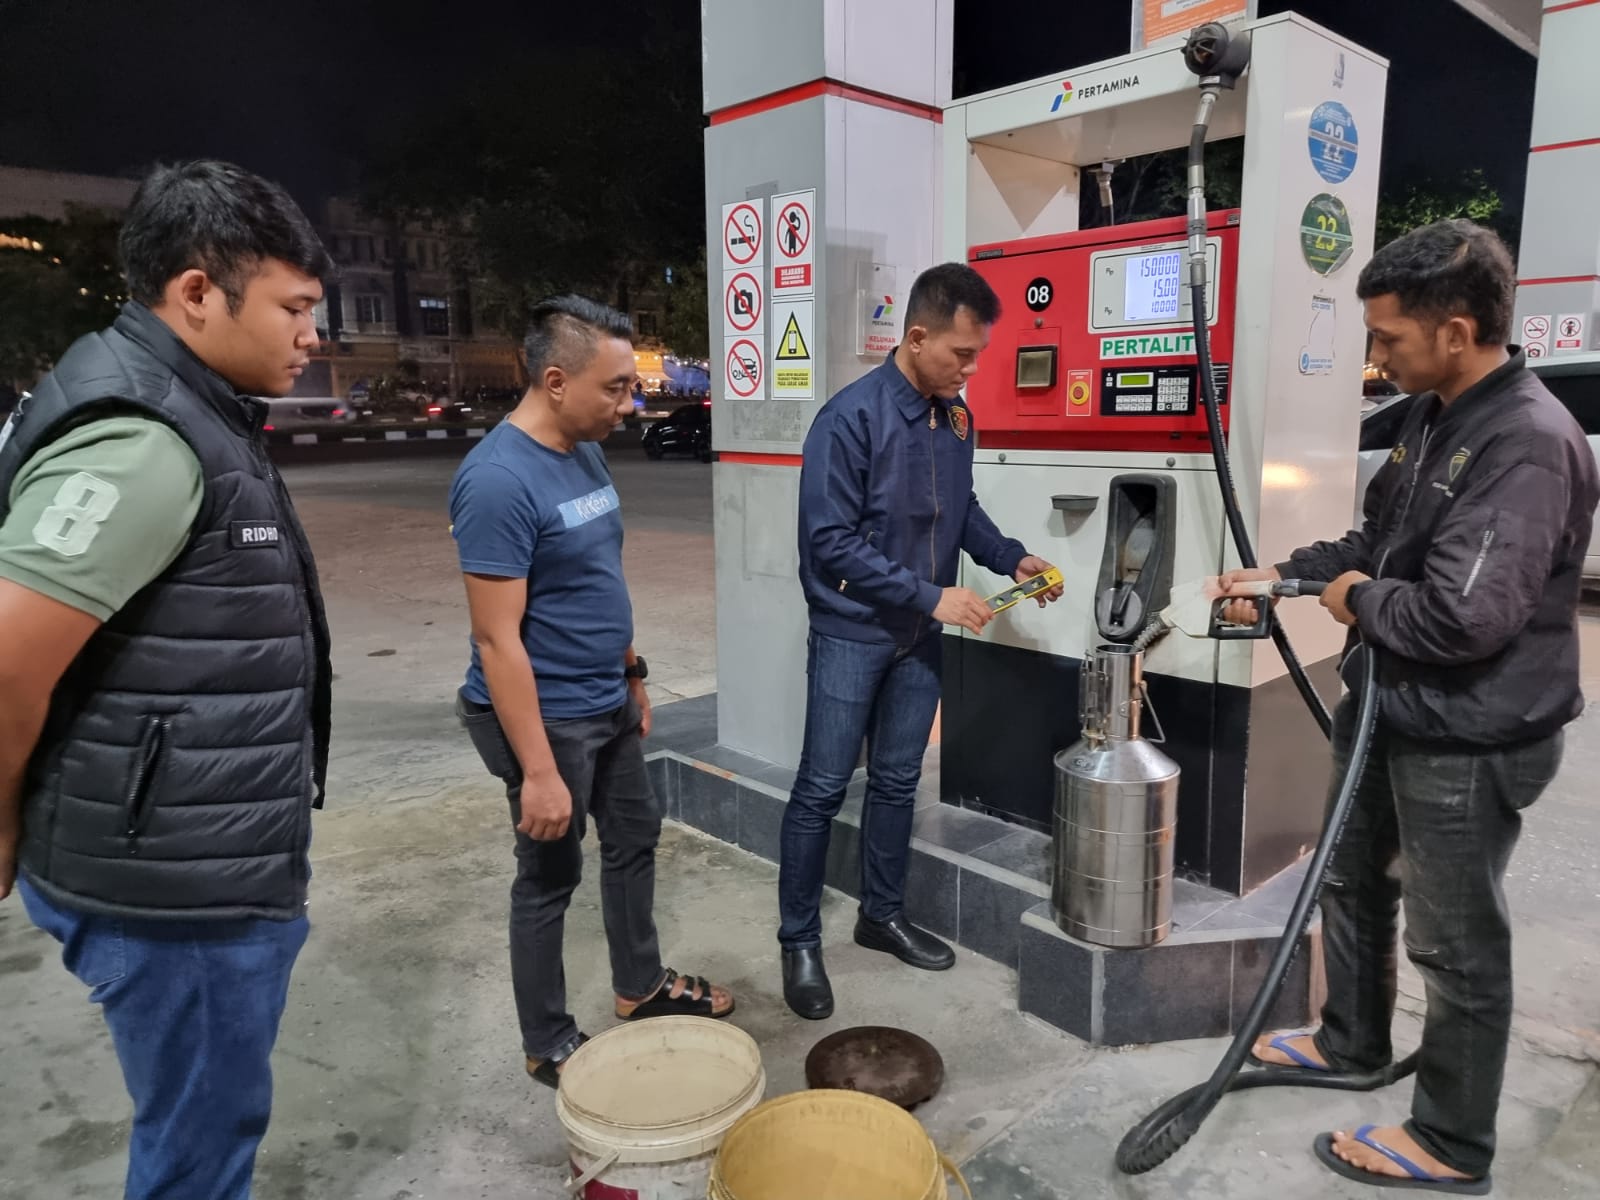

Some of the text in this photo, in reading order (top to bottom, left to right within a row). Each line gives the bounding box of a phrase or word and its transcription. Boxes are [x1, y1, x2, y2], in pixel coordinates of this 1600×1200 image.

[1078, 75, 1140, 100] PERTAMINA
[1140, 254, 1179, 278] 150000
[1027, 285, 1050, 305] 08
[1151, 299, 1177, 313] 10000
[868, 335, 896, 344] KELUHAN
[1102, 335, 1195, 356] PERTALIT
[32, 471, 120, 556] 8
